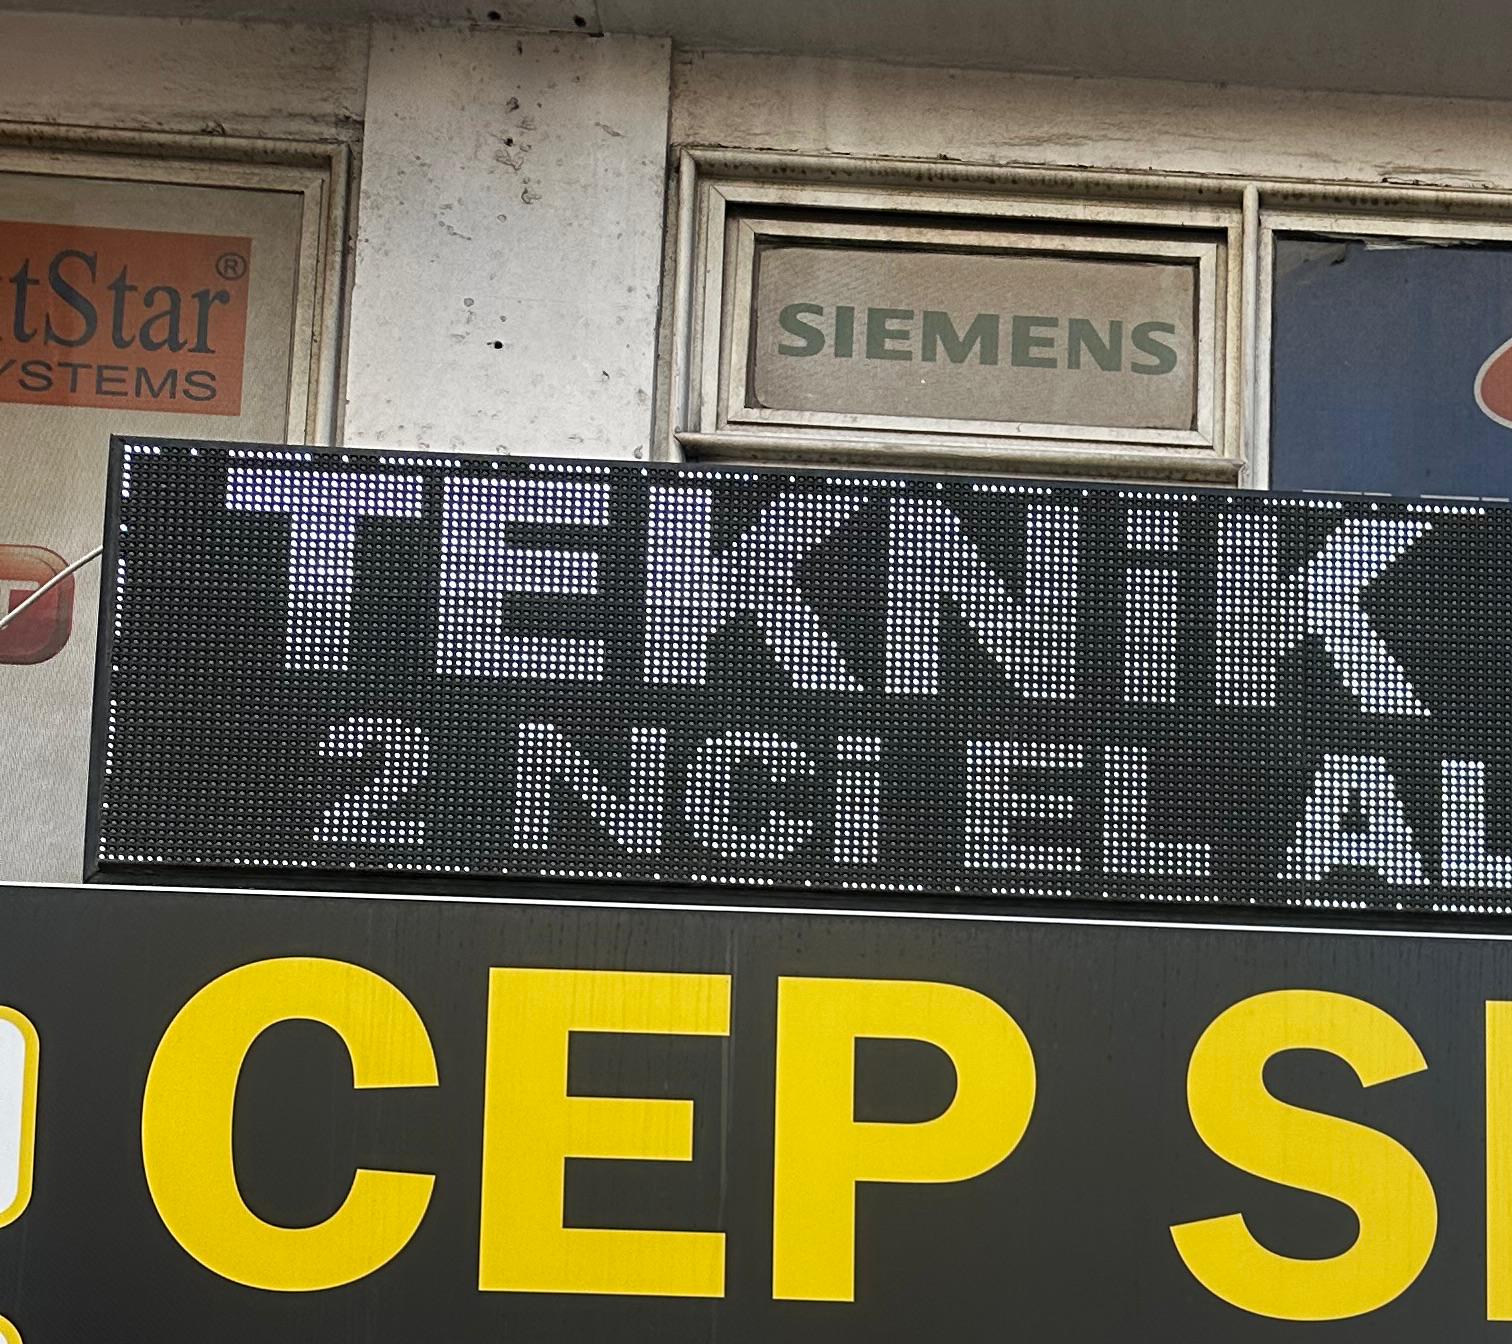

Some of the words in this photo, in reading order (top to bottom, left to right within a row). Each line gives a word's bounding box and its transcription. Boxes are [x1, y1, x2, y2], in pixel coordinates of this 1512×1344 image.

[0, 249, 229, 354] tStar
[777, 303, 1178, 376] SIEMENS
[314, 716, 430, 846] 2
[963, 740, 1211, 877] EL
[140, 956, 1037, 1301] CEP
